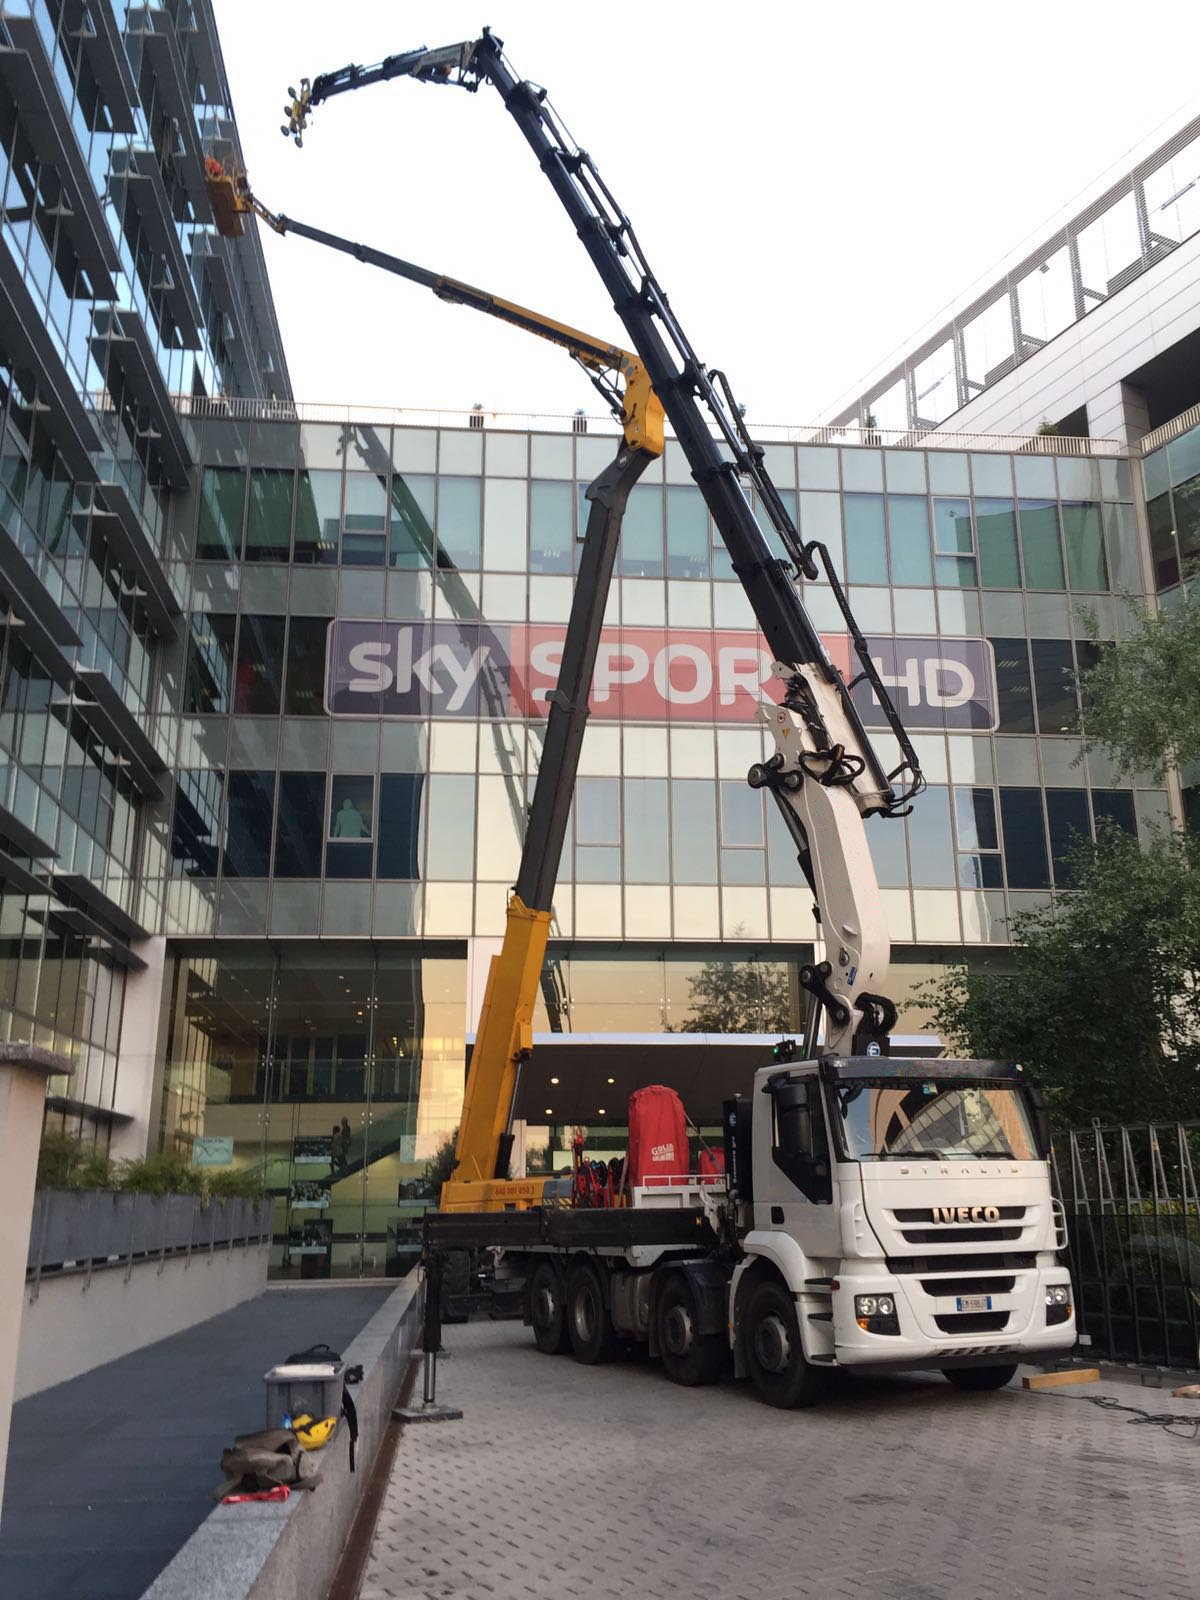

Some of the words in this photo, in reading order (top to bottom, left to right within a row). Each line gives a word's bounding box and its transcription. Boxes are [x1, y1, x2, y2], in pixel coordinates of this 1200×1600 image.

[349, 626, 491, 711] sky
[530, 641, 777, 706] SPOR
[872, 657, 975, 707] HD
[932, 1206, 1000, 1224] IVECO
